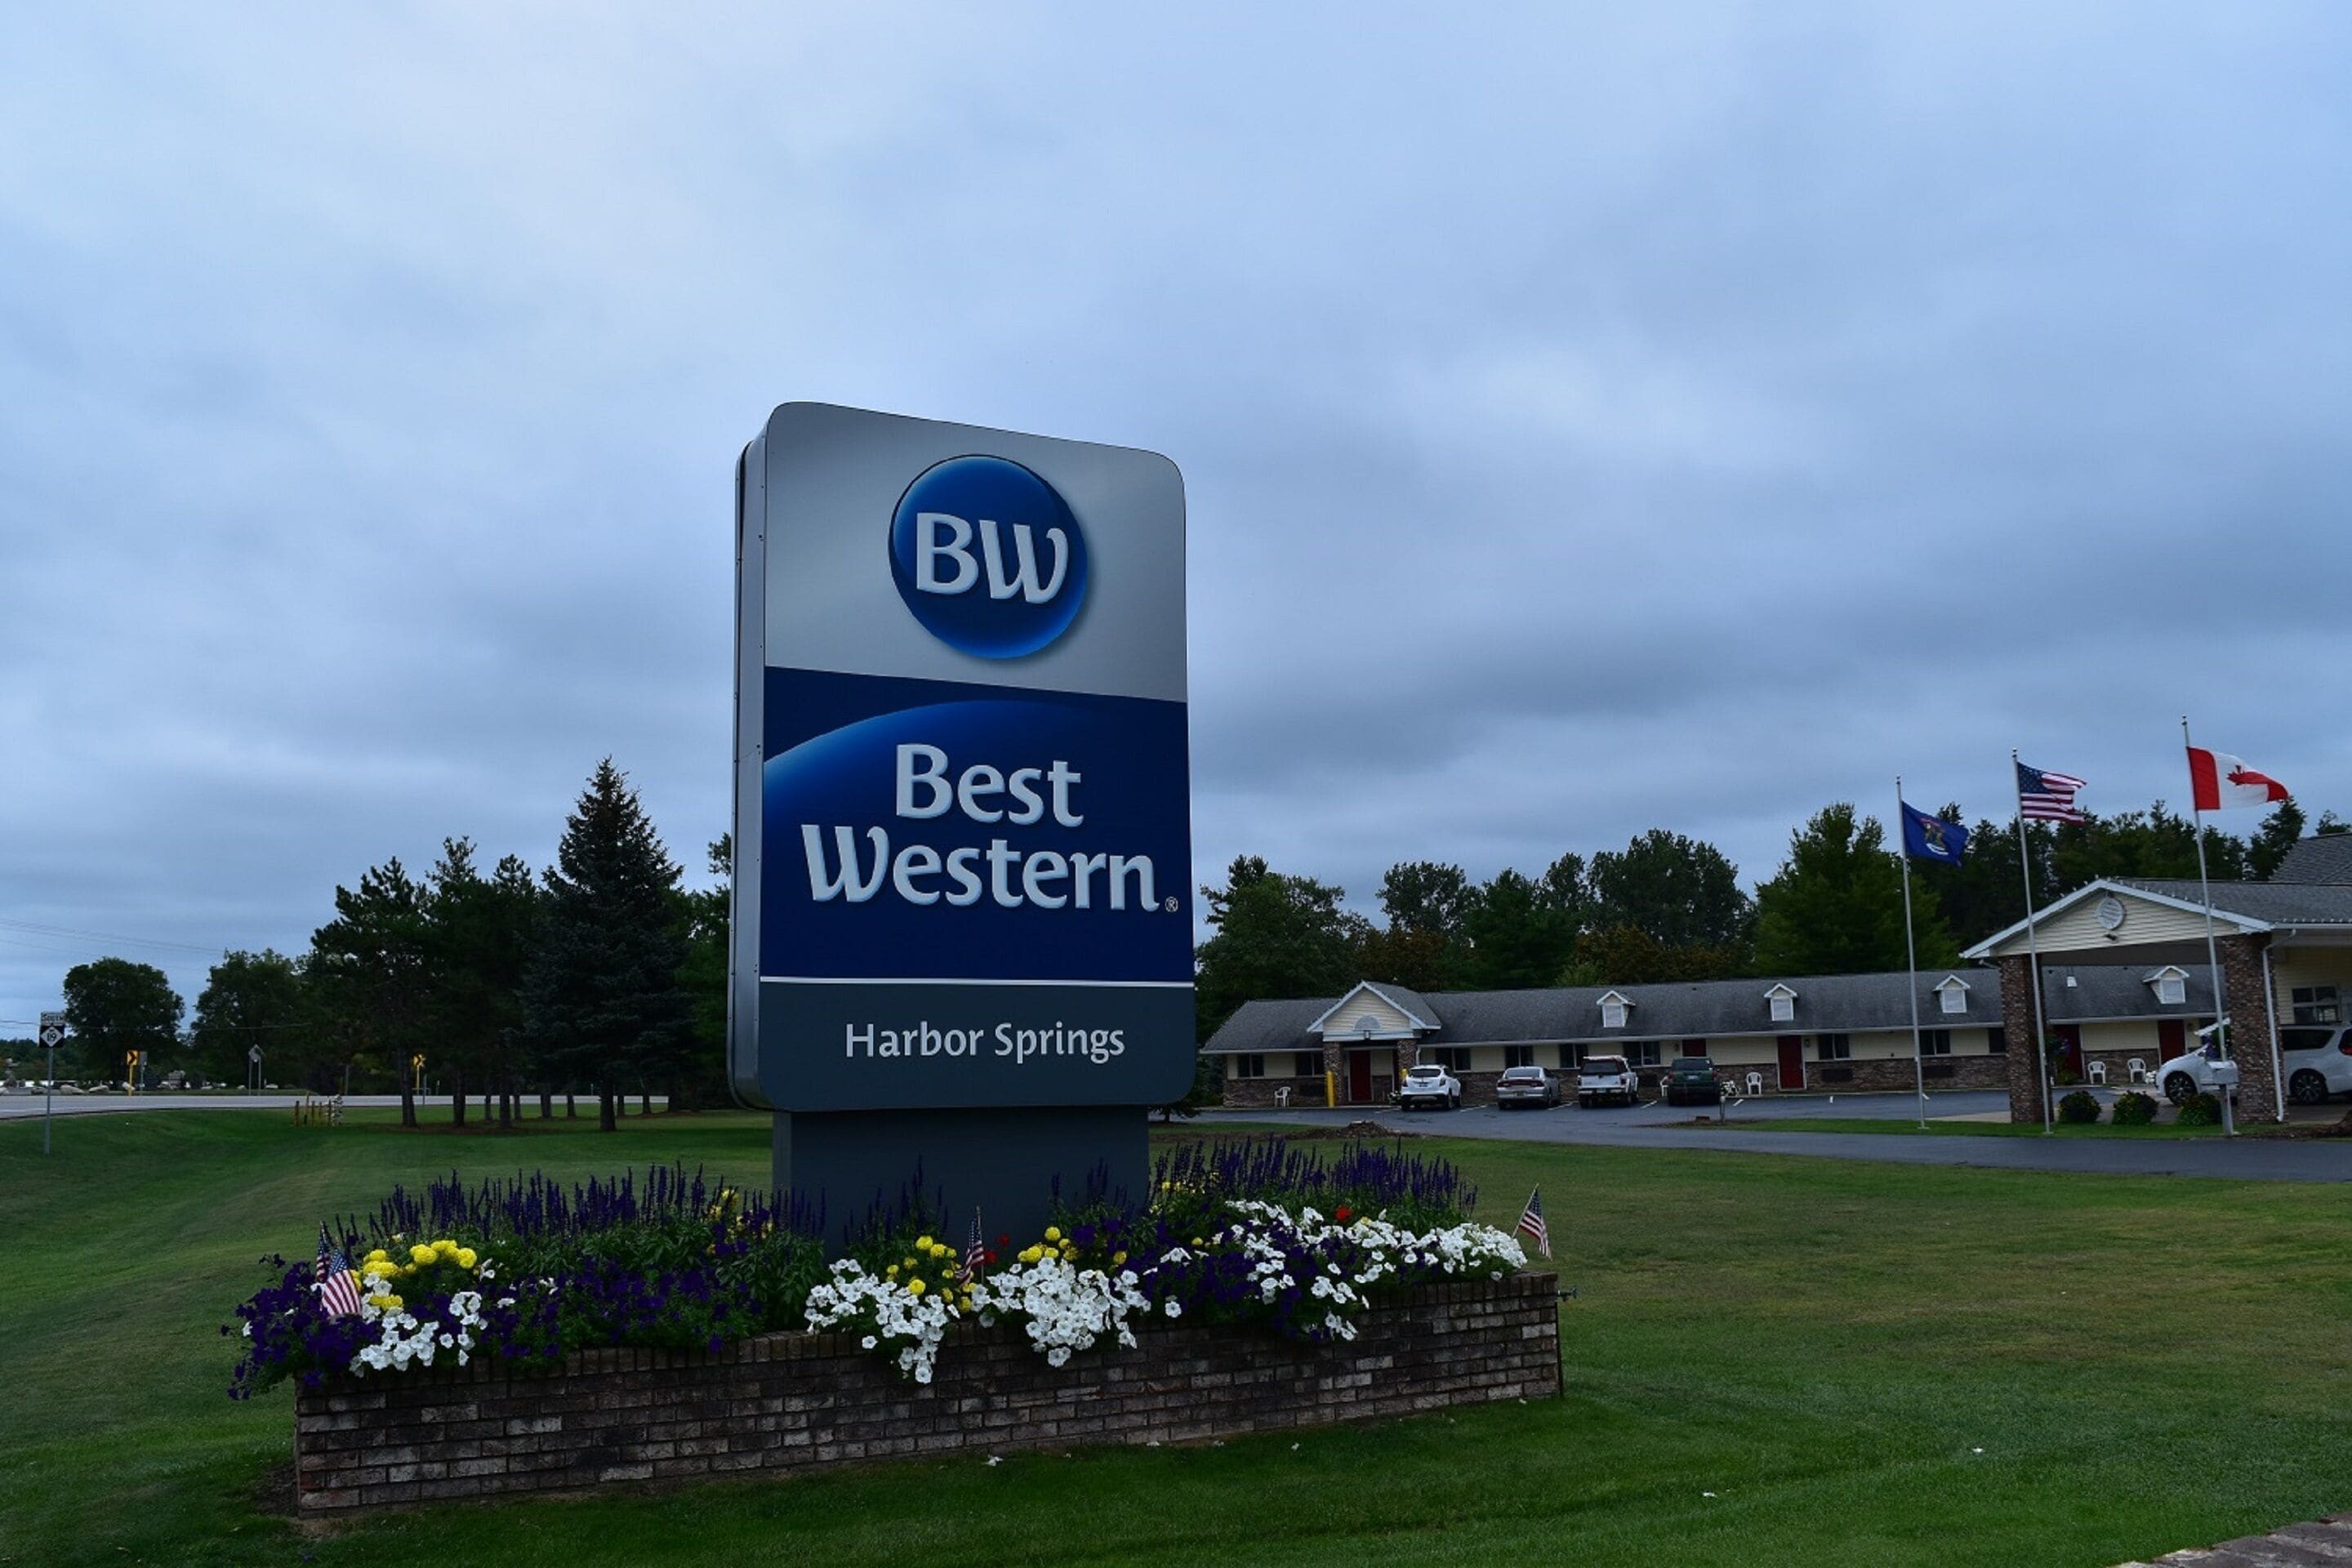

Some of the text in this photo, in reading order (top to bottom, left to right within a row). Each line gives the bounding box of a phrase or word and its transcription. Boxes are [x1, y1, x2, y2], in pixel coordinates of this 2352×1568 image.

[916, 512, 1067, 602] BW
[896, 744, 1084, 826] Best
[846, 1021, 1125, 1064] Harbor Springs
